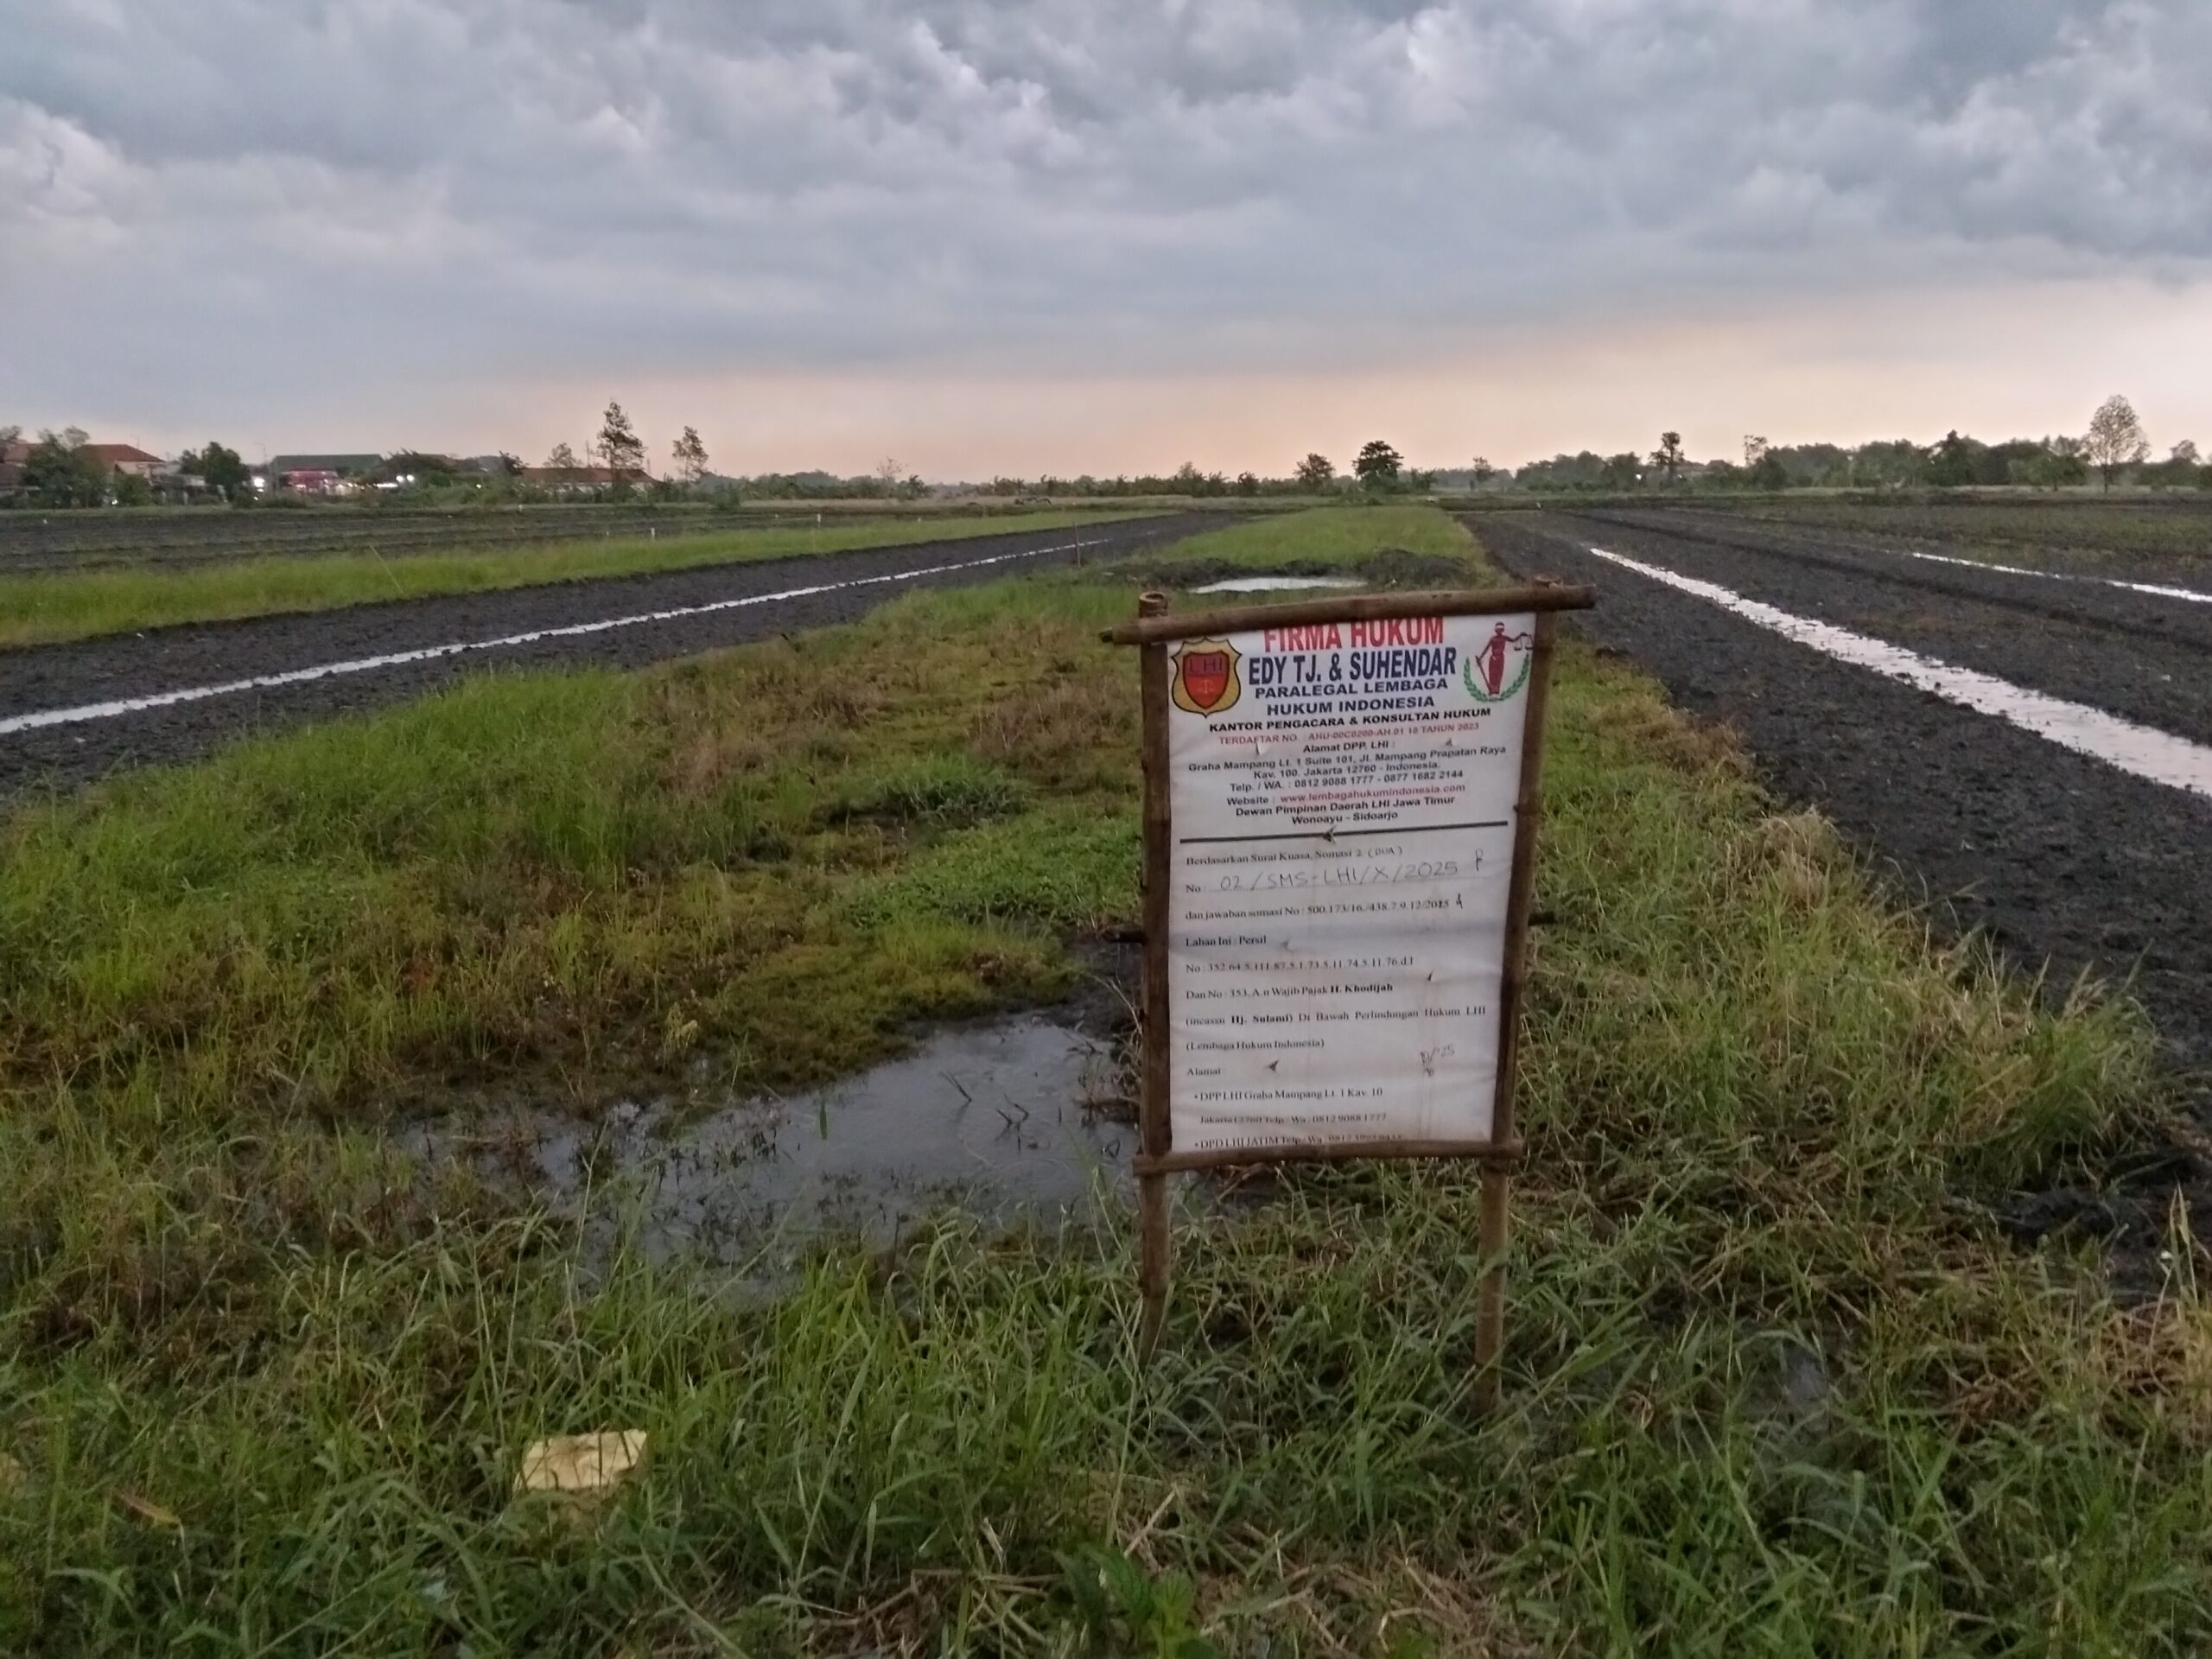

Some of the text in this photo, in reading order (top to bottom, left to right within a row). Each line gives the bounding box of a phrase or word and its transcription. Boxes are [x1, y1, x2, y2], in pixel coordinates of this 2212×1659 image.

[1264, 617, 1443, 653] FIRMA HUKUM
[1188, 657, 1224, 675] LHI
[1249, 646, 1457, 685] EDY TJ. & SUHENDAR
[1254, 677, 1449, 700] PARALEGAL LEMBAGA
[1267, 696, 1435, 716] HUKUM INDONESIA
[1210, 707, 1491, 733] KANTOR PENGACARA & KONSULTAN HUKUM
[1219, 734, 1280, 746] TERDAFTAR
[1422, 723, 1455, 734] TAHUN
[1458, 721, 1480, 731] 2023
[1303, 741, 1341, 753] Alamat
[1370, 740, 1389, 749] LHI
[1188, 762, 1220, 772] Graha
[1224, 760, 1276, 772] Mampang
[1296, 758, 1301, 766] 1
[1306, 756, 1332, 766] Suite
[1375, 748, 1427, 762] Mampang
[1430, 745, 1478, 759] Prapatan
[1480, 744, 1507, 756] Raya
[1294, 779, 1319, 787] 0812
[1351, 776, 1374, 785] 1777
[1384, 773, 1408, 782] 0877
[1440, 770, 1464, 779] 2144
[1303, 766, 1343, 777] Jakarta
[1346, 765, 1376, 773] 12760
[1227, 797, 1269, 806] Website
[1280, 785, 1466, 804] www.lembagahukumindonesia.com
[1236, 796, 1455, 817] Dewan Pimpinan Daerah LHI Jawa Timur
[1292, 815, 1344, 826] Wonoayu
[1353, 811, 1399, 823] Sidoarjo
[1186, 852, 1249, 866] Berdasarkan
[1185, 884, 1201, 893] No
[1185, 910, 1204, 920] dan
[1205, 908, 1245, 921] jawaban
[1248, 908, 1282, 918] somasi
[1285, 906, 1300, 916] No
[1185, 937, 1216, 947] Lahan
[1218, 936, 1231, 946] Ini
[1239, 934, 1267, 946] Persil
[1185, 963, 1201, 973] No
[1185, 990, 1205, 1000] Dan
[1208, 989, 1223, 999] No
[1272, 986, 1300, 997] Wajib
[1302, 985, 1327, 996] Pajak
[1344, 982, 1394, 995] Khodijah
[1316, 1011, 1350, 1022] Bawah
[1355, 1007, 1419, 1020] Perlindungan
[1425, 1007, 1460, 1018] Hukum
[1465, 1005, 1486, 1016] LHI
[1236, 1039, 1273, 1051] Hukum
[1186, 1067, 1221, 1077] Alamat
[1200, 1091, 1223, 1102] DPP
[1244, 1090, 1273, 1100] Graha
[1274, 1089, 1323, 1101] Mampang
